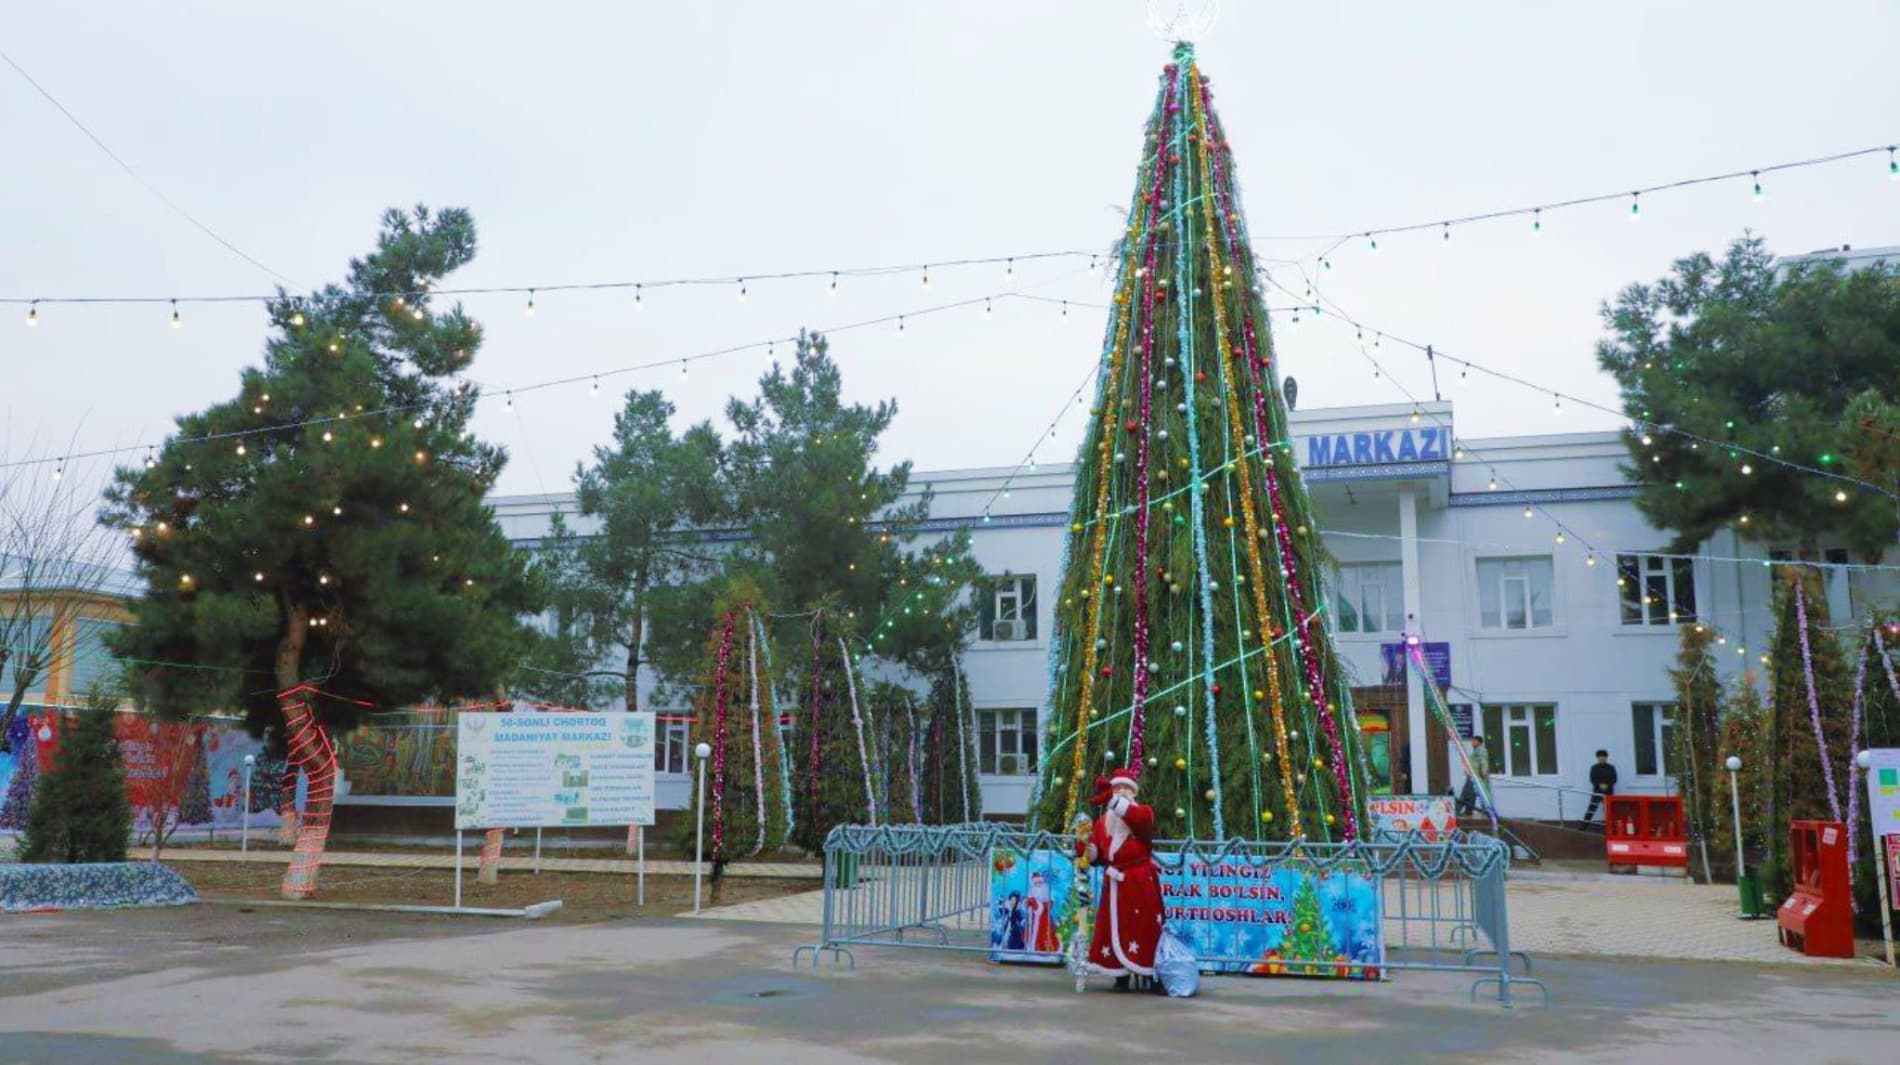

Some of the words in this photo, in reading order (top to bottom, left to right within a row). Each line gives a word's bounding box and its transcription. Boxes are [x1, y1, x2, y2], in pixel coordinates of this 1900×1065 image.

[1308, 429, 1448, 467] MARKAZI
[494, 732, 557, 742] MADANIYAT
[561, 732, 611, 742] MARKAZI
[1161, 883, 1202, 898] RAK
